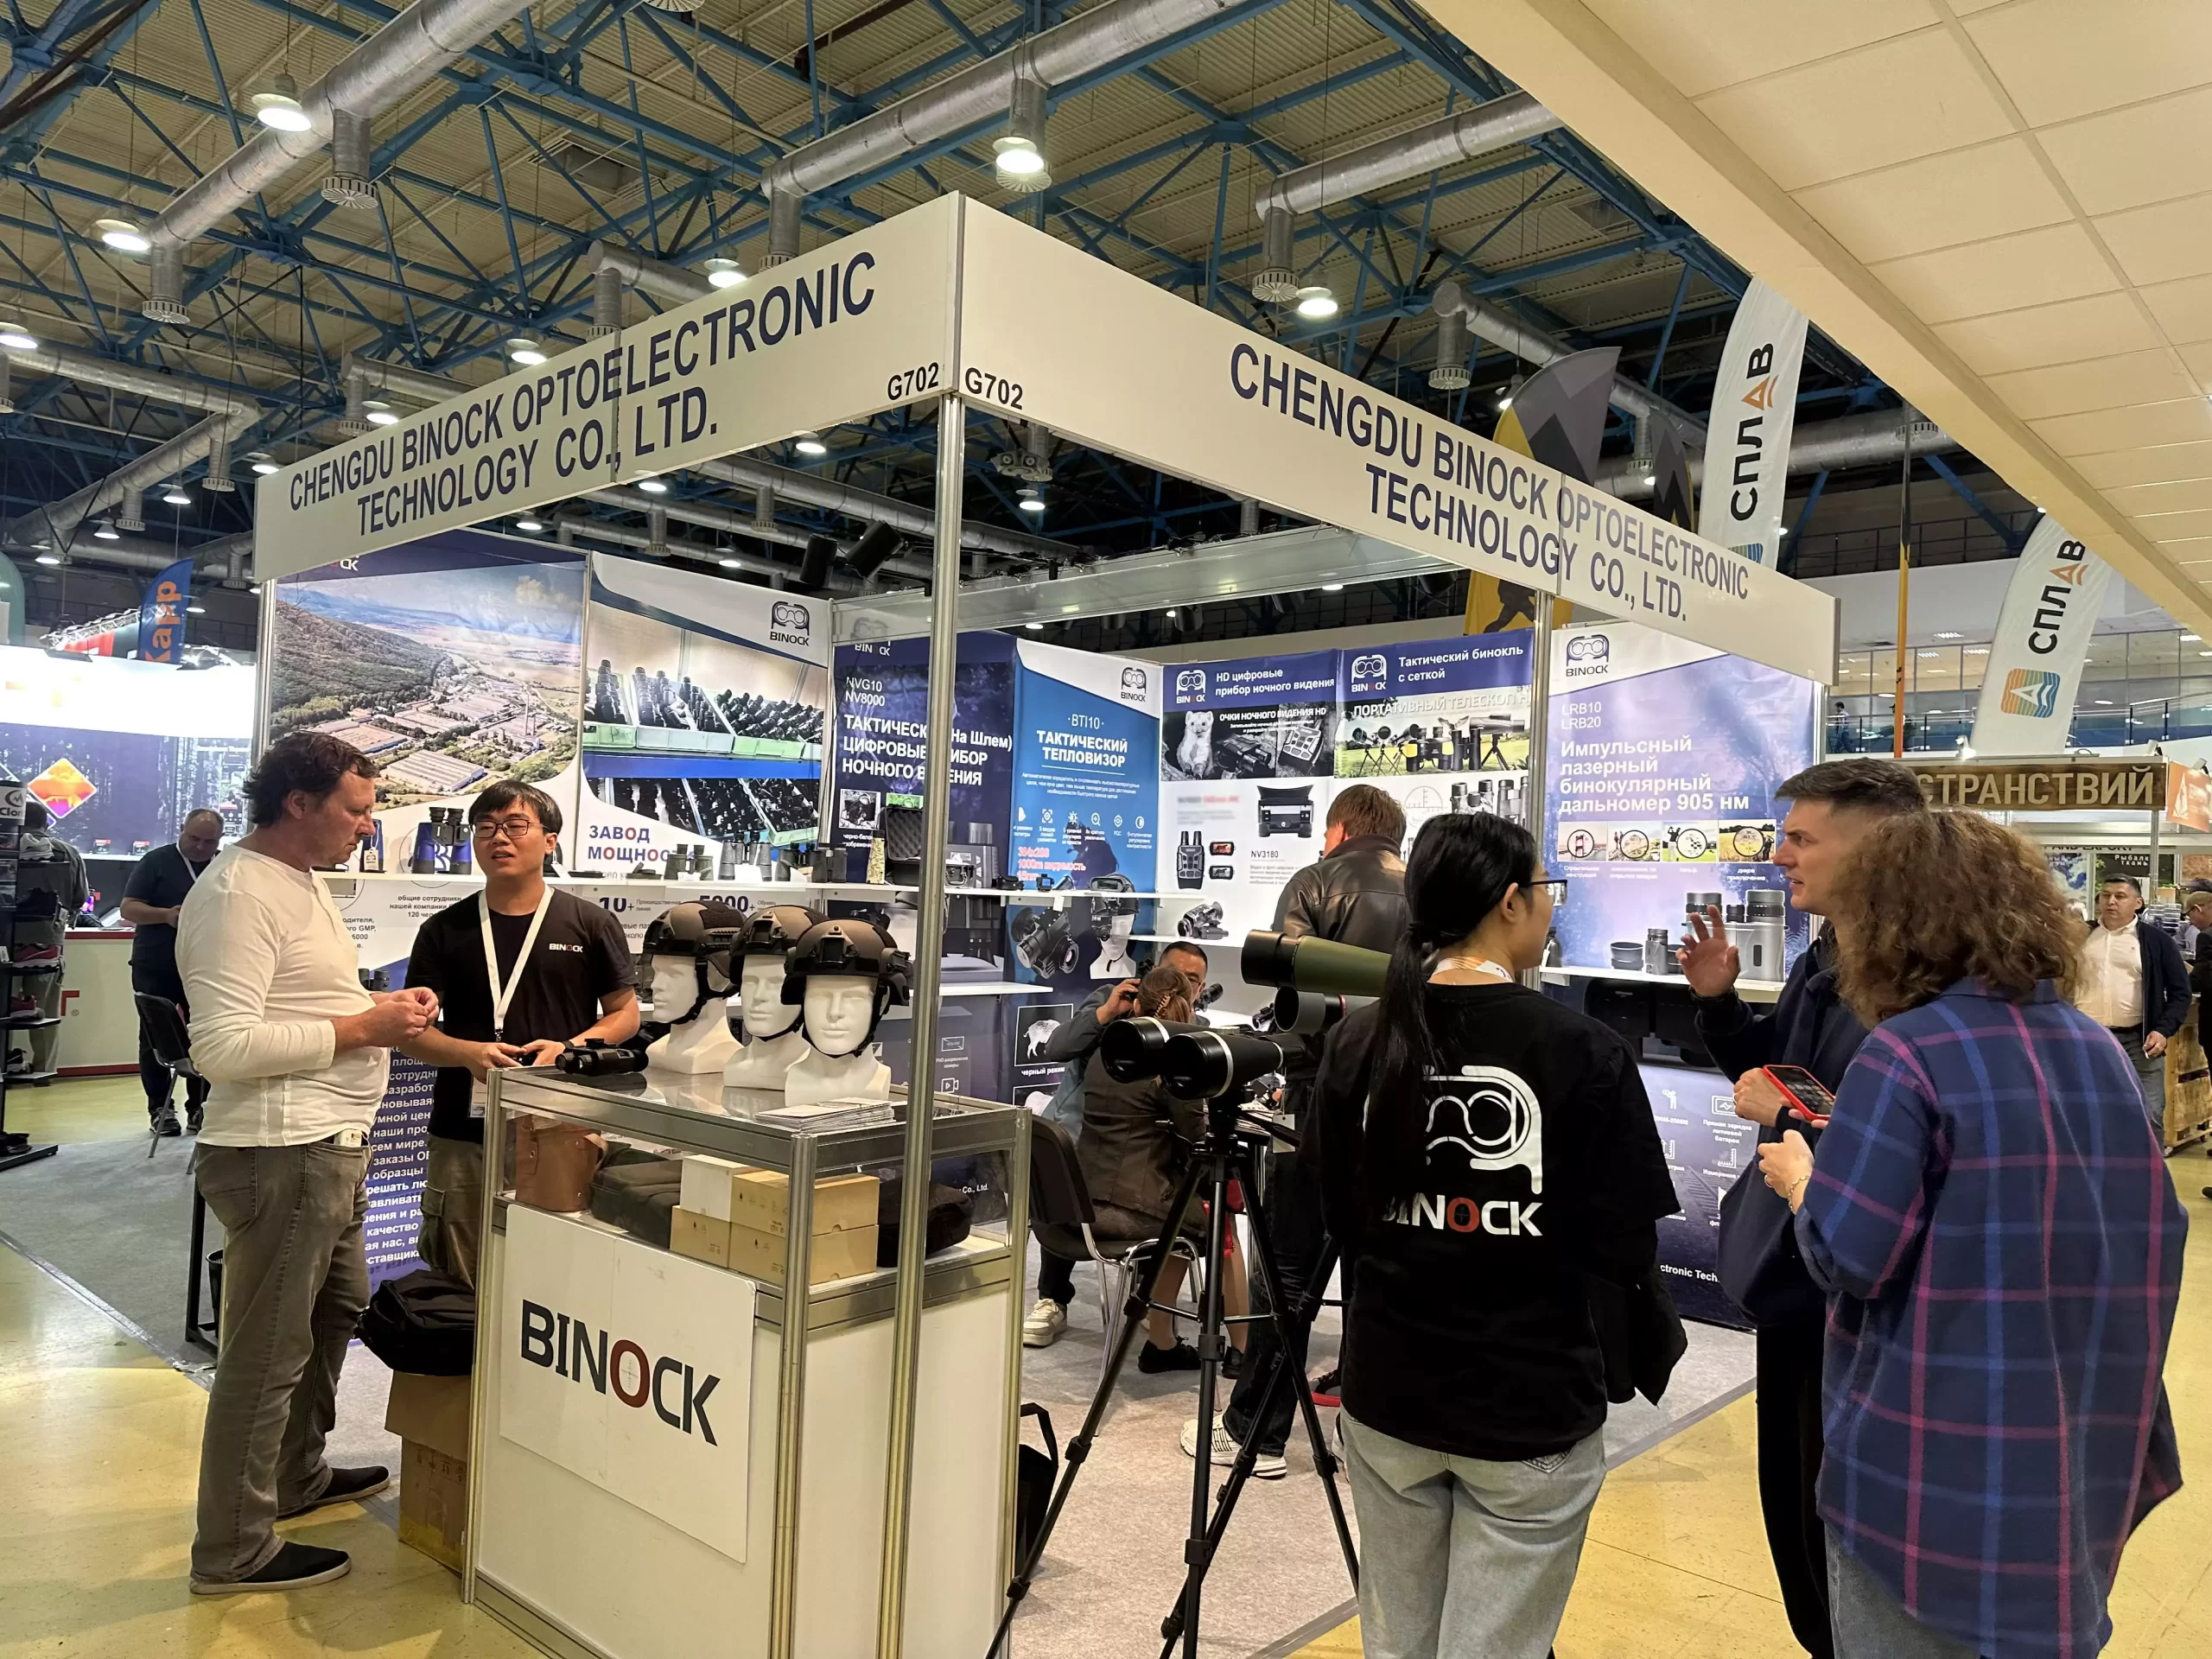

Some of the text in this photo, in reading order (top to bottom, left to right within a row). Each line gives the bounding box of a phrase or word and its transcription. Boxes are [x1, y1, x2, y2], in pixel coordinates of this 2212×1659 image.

[290, 251, 876, 511] CHENGDU BINOCK OPTOELECTRONIC
[887, 361, 939, 401] G702
[964, 367, 1024, 410] G702
[357, 386, 718, 537] TECHNOLOGY CO., LTD.
[1230, 343, 1749, 601] CHENGDU BINOCK OPTOELECTRONIC
[1365, 463, 1687, 621] TECHNOLOGY CO., LTD.
[770, 631, 810, 646] BINOCK
[855, 643, 891, 657] BINCK
[1398, 645, 1524, 668] Тактический бинокль
[1216, 669, 1283, 683] HD цифровые
[1408, 668, 1446, 682] сеткой
[1566, 663, 1609, 677] BINOCK
[846, 677, 882, 692] NVG10
[1215, 678, 1335, 697] прибор ночного видения
[845, 690, 886, 707] NV8000
[1121, 691, 1147, 702] BINOCK
[1353, 691, 1532, 717] ПОРТАТИВНЫЙ ТЕЛЕСКОП H
[1219, 707, 1327, 721] ОЧКИ НОЧНОГО ВИДЕНИЯ HD
[1561, 702, 1602, 715] LRB10
[1561, 716, 1602, 731] LRB20
[843, 714, 927, 739] ТАКТИЧЕСК
[970, 730, 1013, 752] Шлем)
[1036, 730, 1128, 753] ТАКТИЧЕСКИЙ
[1560, 735, 1693, 758] Импульсный
[950, 748, 988, 766] ИБОР
[1042, 747, 1126, 767] ТЕПЛОВИЗОР
[1560, 756, 1658, 775] лазерный
[842, 758, 982, 786] НОЧНОГО ВЕНИЯ
[1560, 774, 1711, 796] бинокулярный
[1916, 766, 2153, 804] СТРАНСТВИЙ
[1558, 793, 1750, 815] дальномер 905 нм
[589, 825, 651, 843] ЗАВОД
[588, 846, 695, 864] МОЩНОС
[549, 943, 583, 953] BINOCK
[392, 1058, 427, 1067] площ
[1021, 1066, 1066, 1077] черный режим
[379, 1098, 434, 1109] новывая
[373, 1126, 429, 1138] наши про
[372, 1140, 428, 1152] сем мире.
[373, 1154, 413, 1166] заказы
[372, 1167, 423, 1181] образцы
[962, 1183, 989, 1193] Co., Ltd.
[399, 1210, 407, 1218] и
[366, 1223, 418, 1236] качество
[365, 1242, 378, 1251] ая
[382, 1238, 405, 1249] нас,
[1660, 1264, 1719, 1283] ctronic Tech
[521, 1298, 721, 1446] BINOCK
